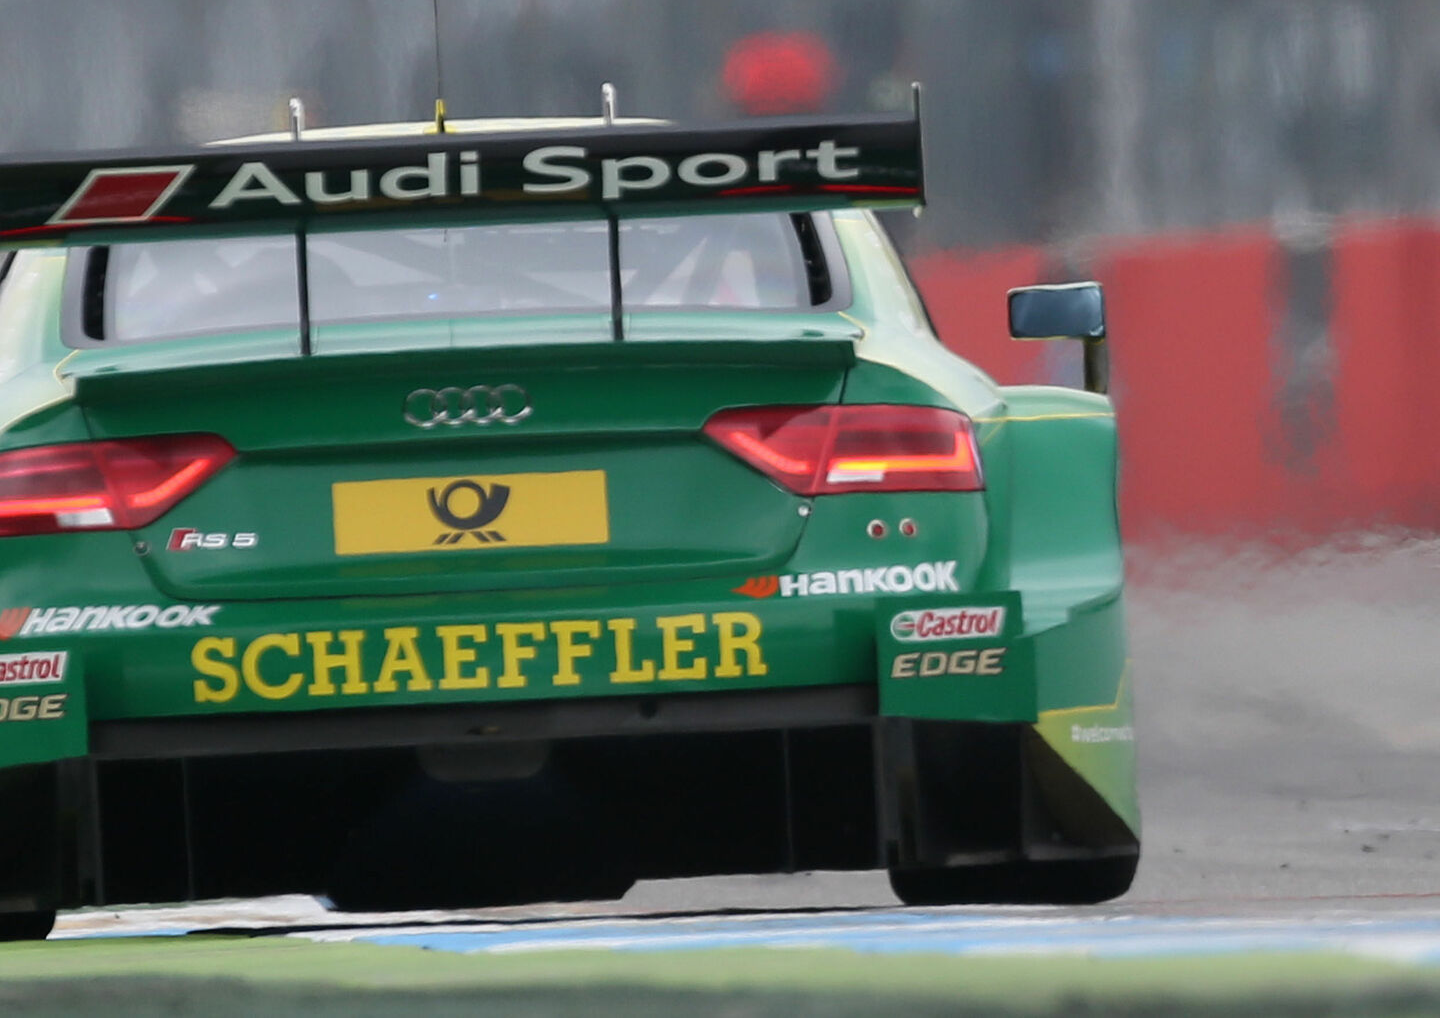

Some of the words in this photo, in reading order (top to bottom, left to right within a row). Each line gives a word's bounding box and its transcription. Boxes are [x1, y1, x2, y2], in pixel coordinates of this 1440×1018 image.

[208, 151, 479, 209] Audi
[521, 139, 860, 199] Sport
[178, 531, 229, 550] RS
[231, 532, 258, 549] 5
[916, 609, 999, 638] Castrol
[190, 611, 767, 703] SCHAEFFLER
[890, 647, 1007, 678] EDGE
